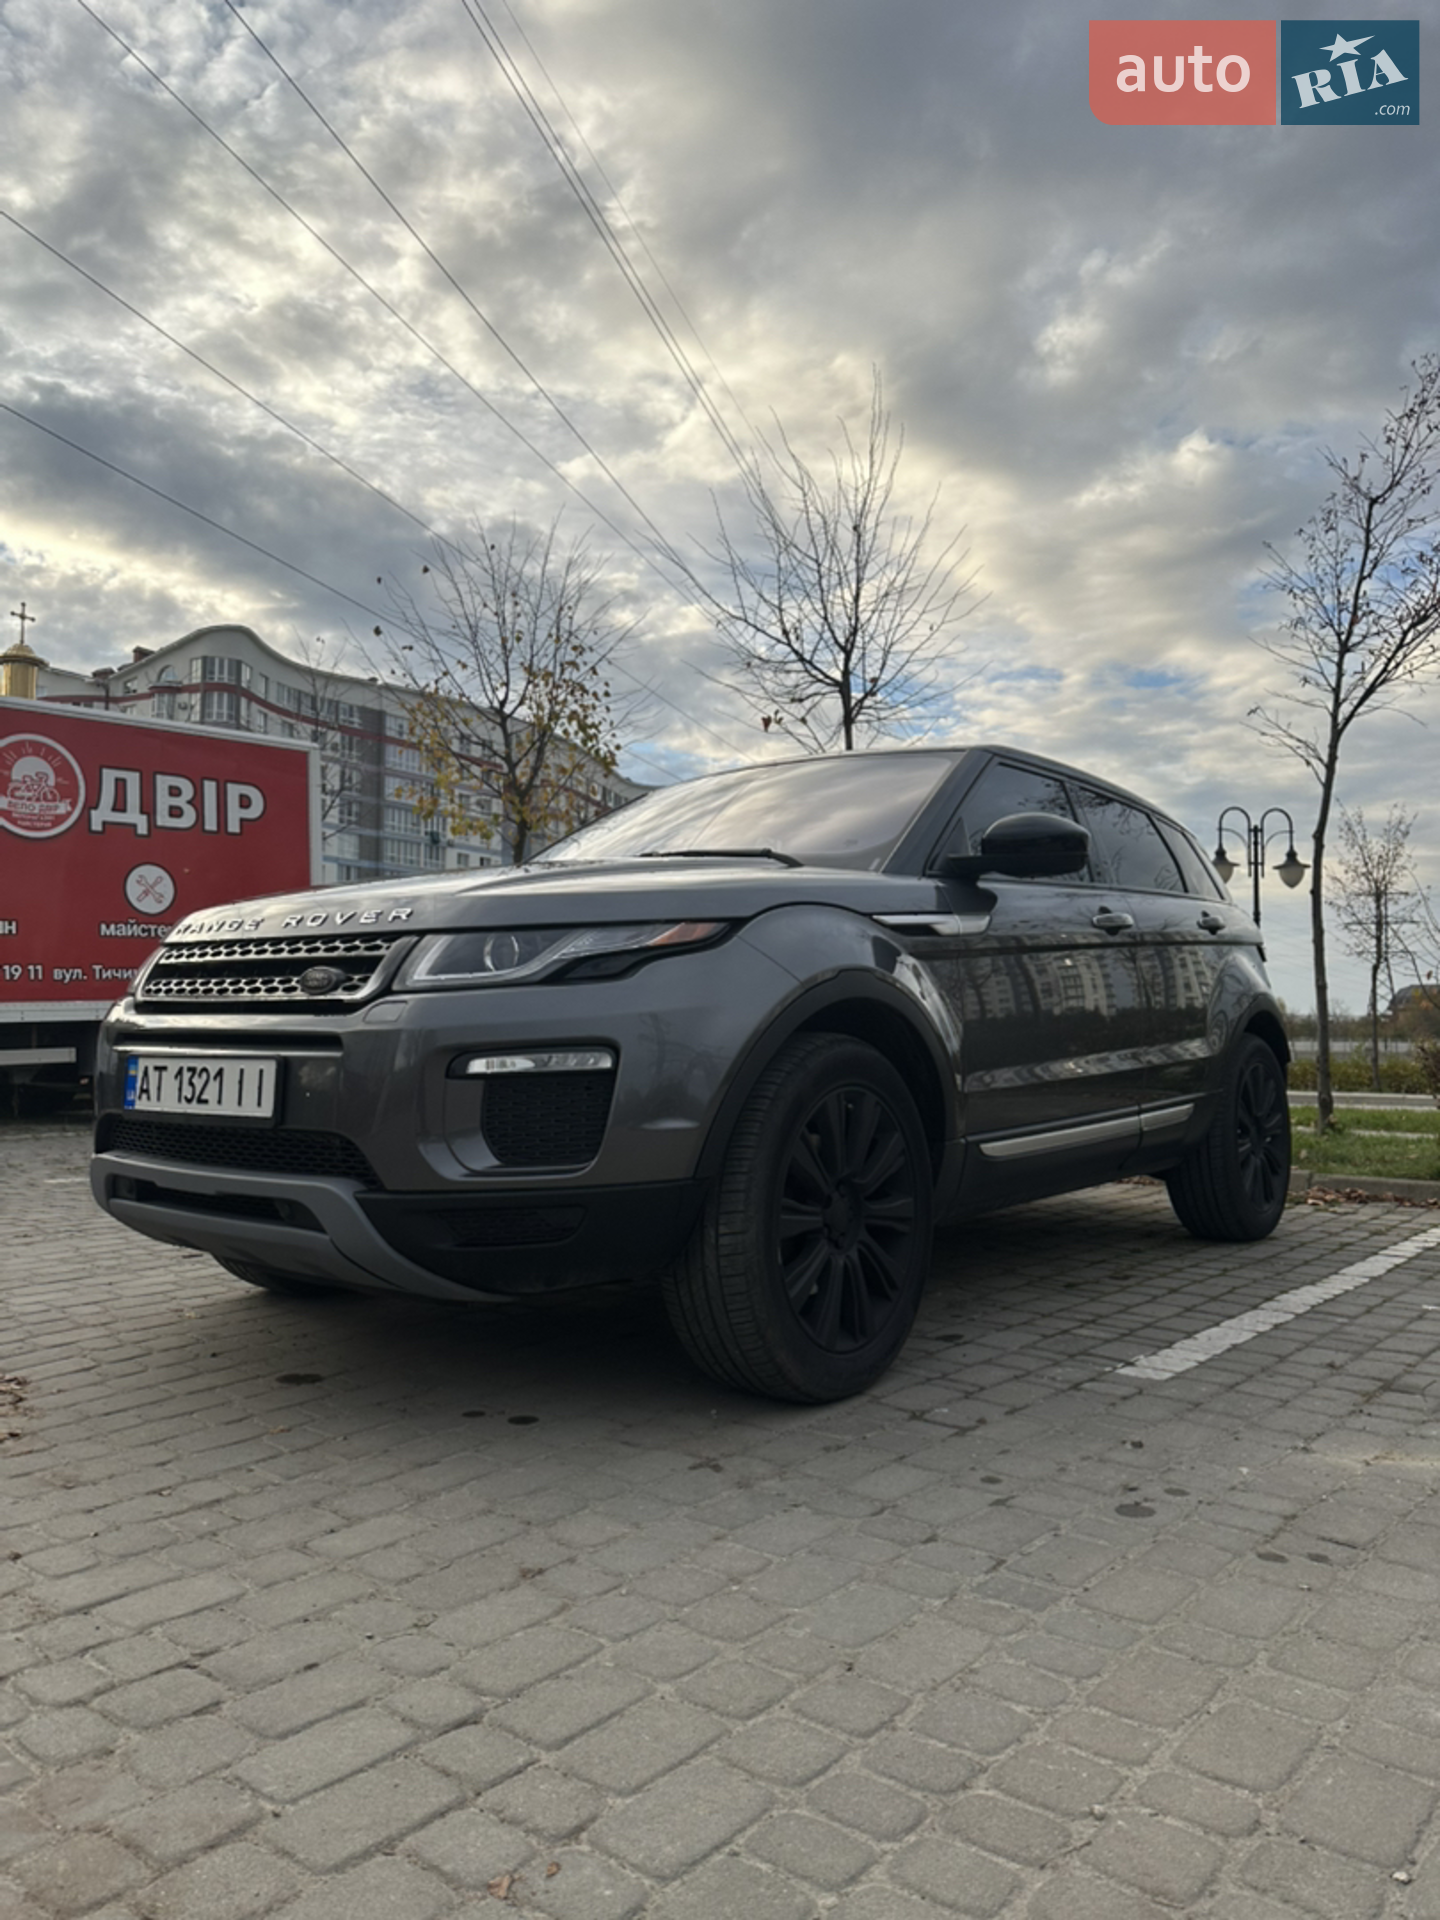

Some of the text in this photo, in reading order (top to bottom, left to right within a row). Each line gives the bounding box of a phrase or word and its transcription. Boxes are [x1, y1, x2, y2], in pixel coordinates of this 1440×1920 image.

[89, 766, 266, 836] ДВІР
[100, 918, 173, 938] майсте
[281, 907, 415, 930] ROVER
[3, 965, 22, 980] 19
[28, 965, 43, 980] 11
[53, 967, 88, 984] вул.
[138, 1065, 168, 1102] AT
[174, 1066, 225, 1106] 1321
